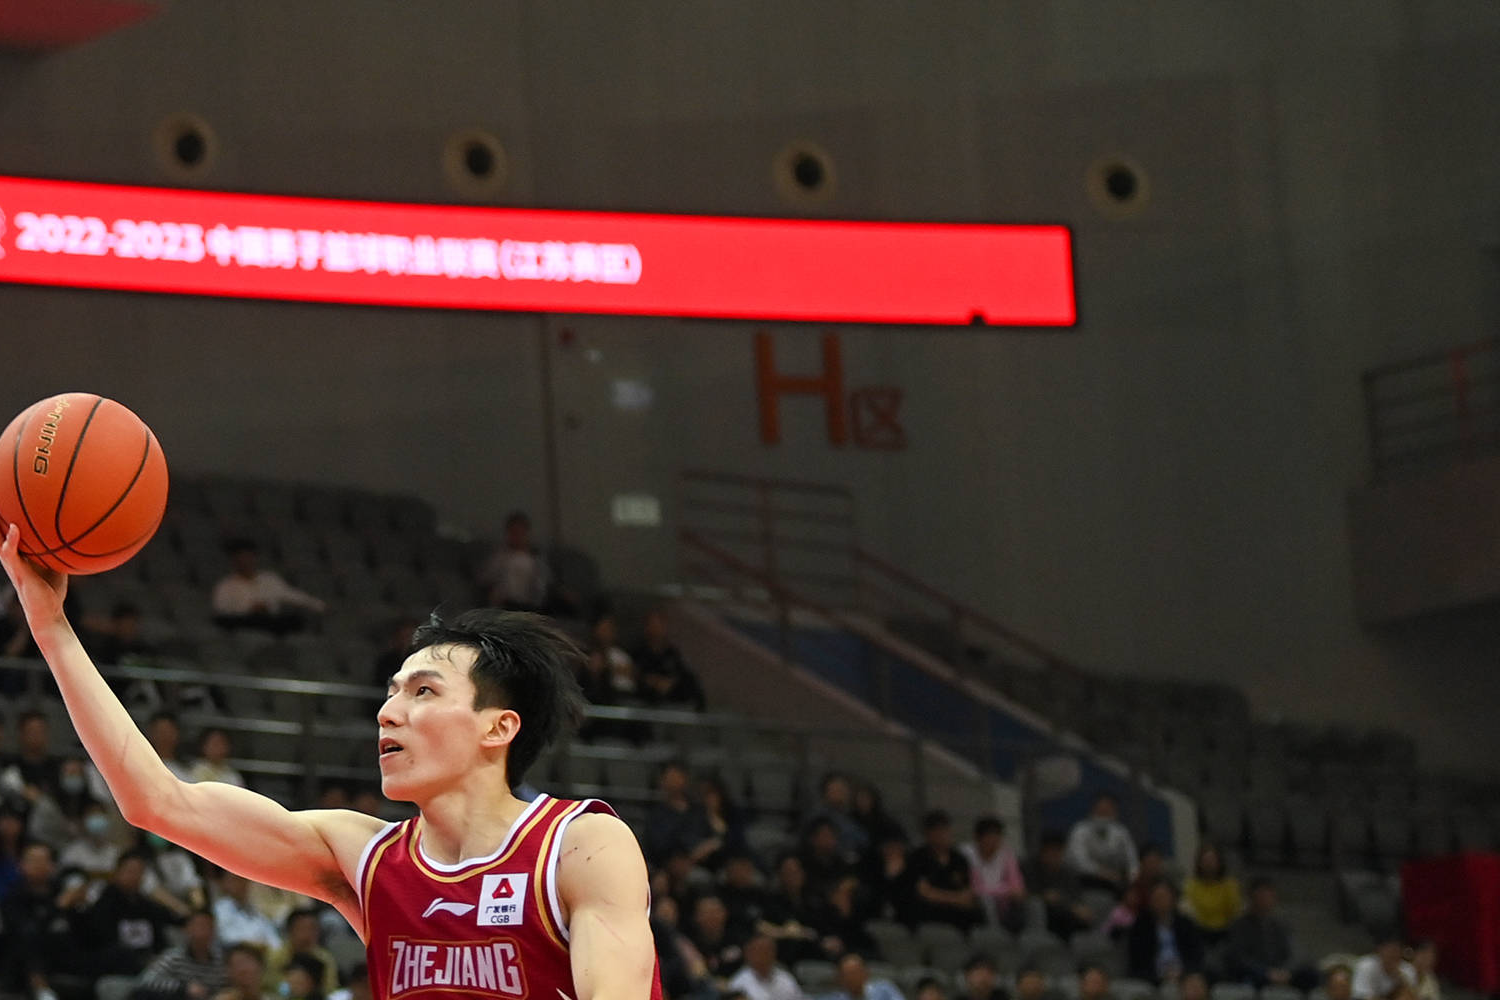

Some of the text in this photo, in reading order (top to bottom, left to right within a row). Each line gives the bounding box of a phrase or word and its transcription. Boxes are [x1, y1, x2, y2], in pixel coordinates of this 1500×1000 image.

[14, 212, 205, 262] 2022-2023
[490, 914, 510, 924] CGB
[390, 939, 524, 997] ZHEJIANG
